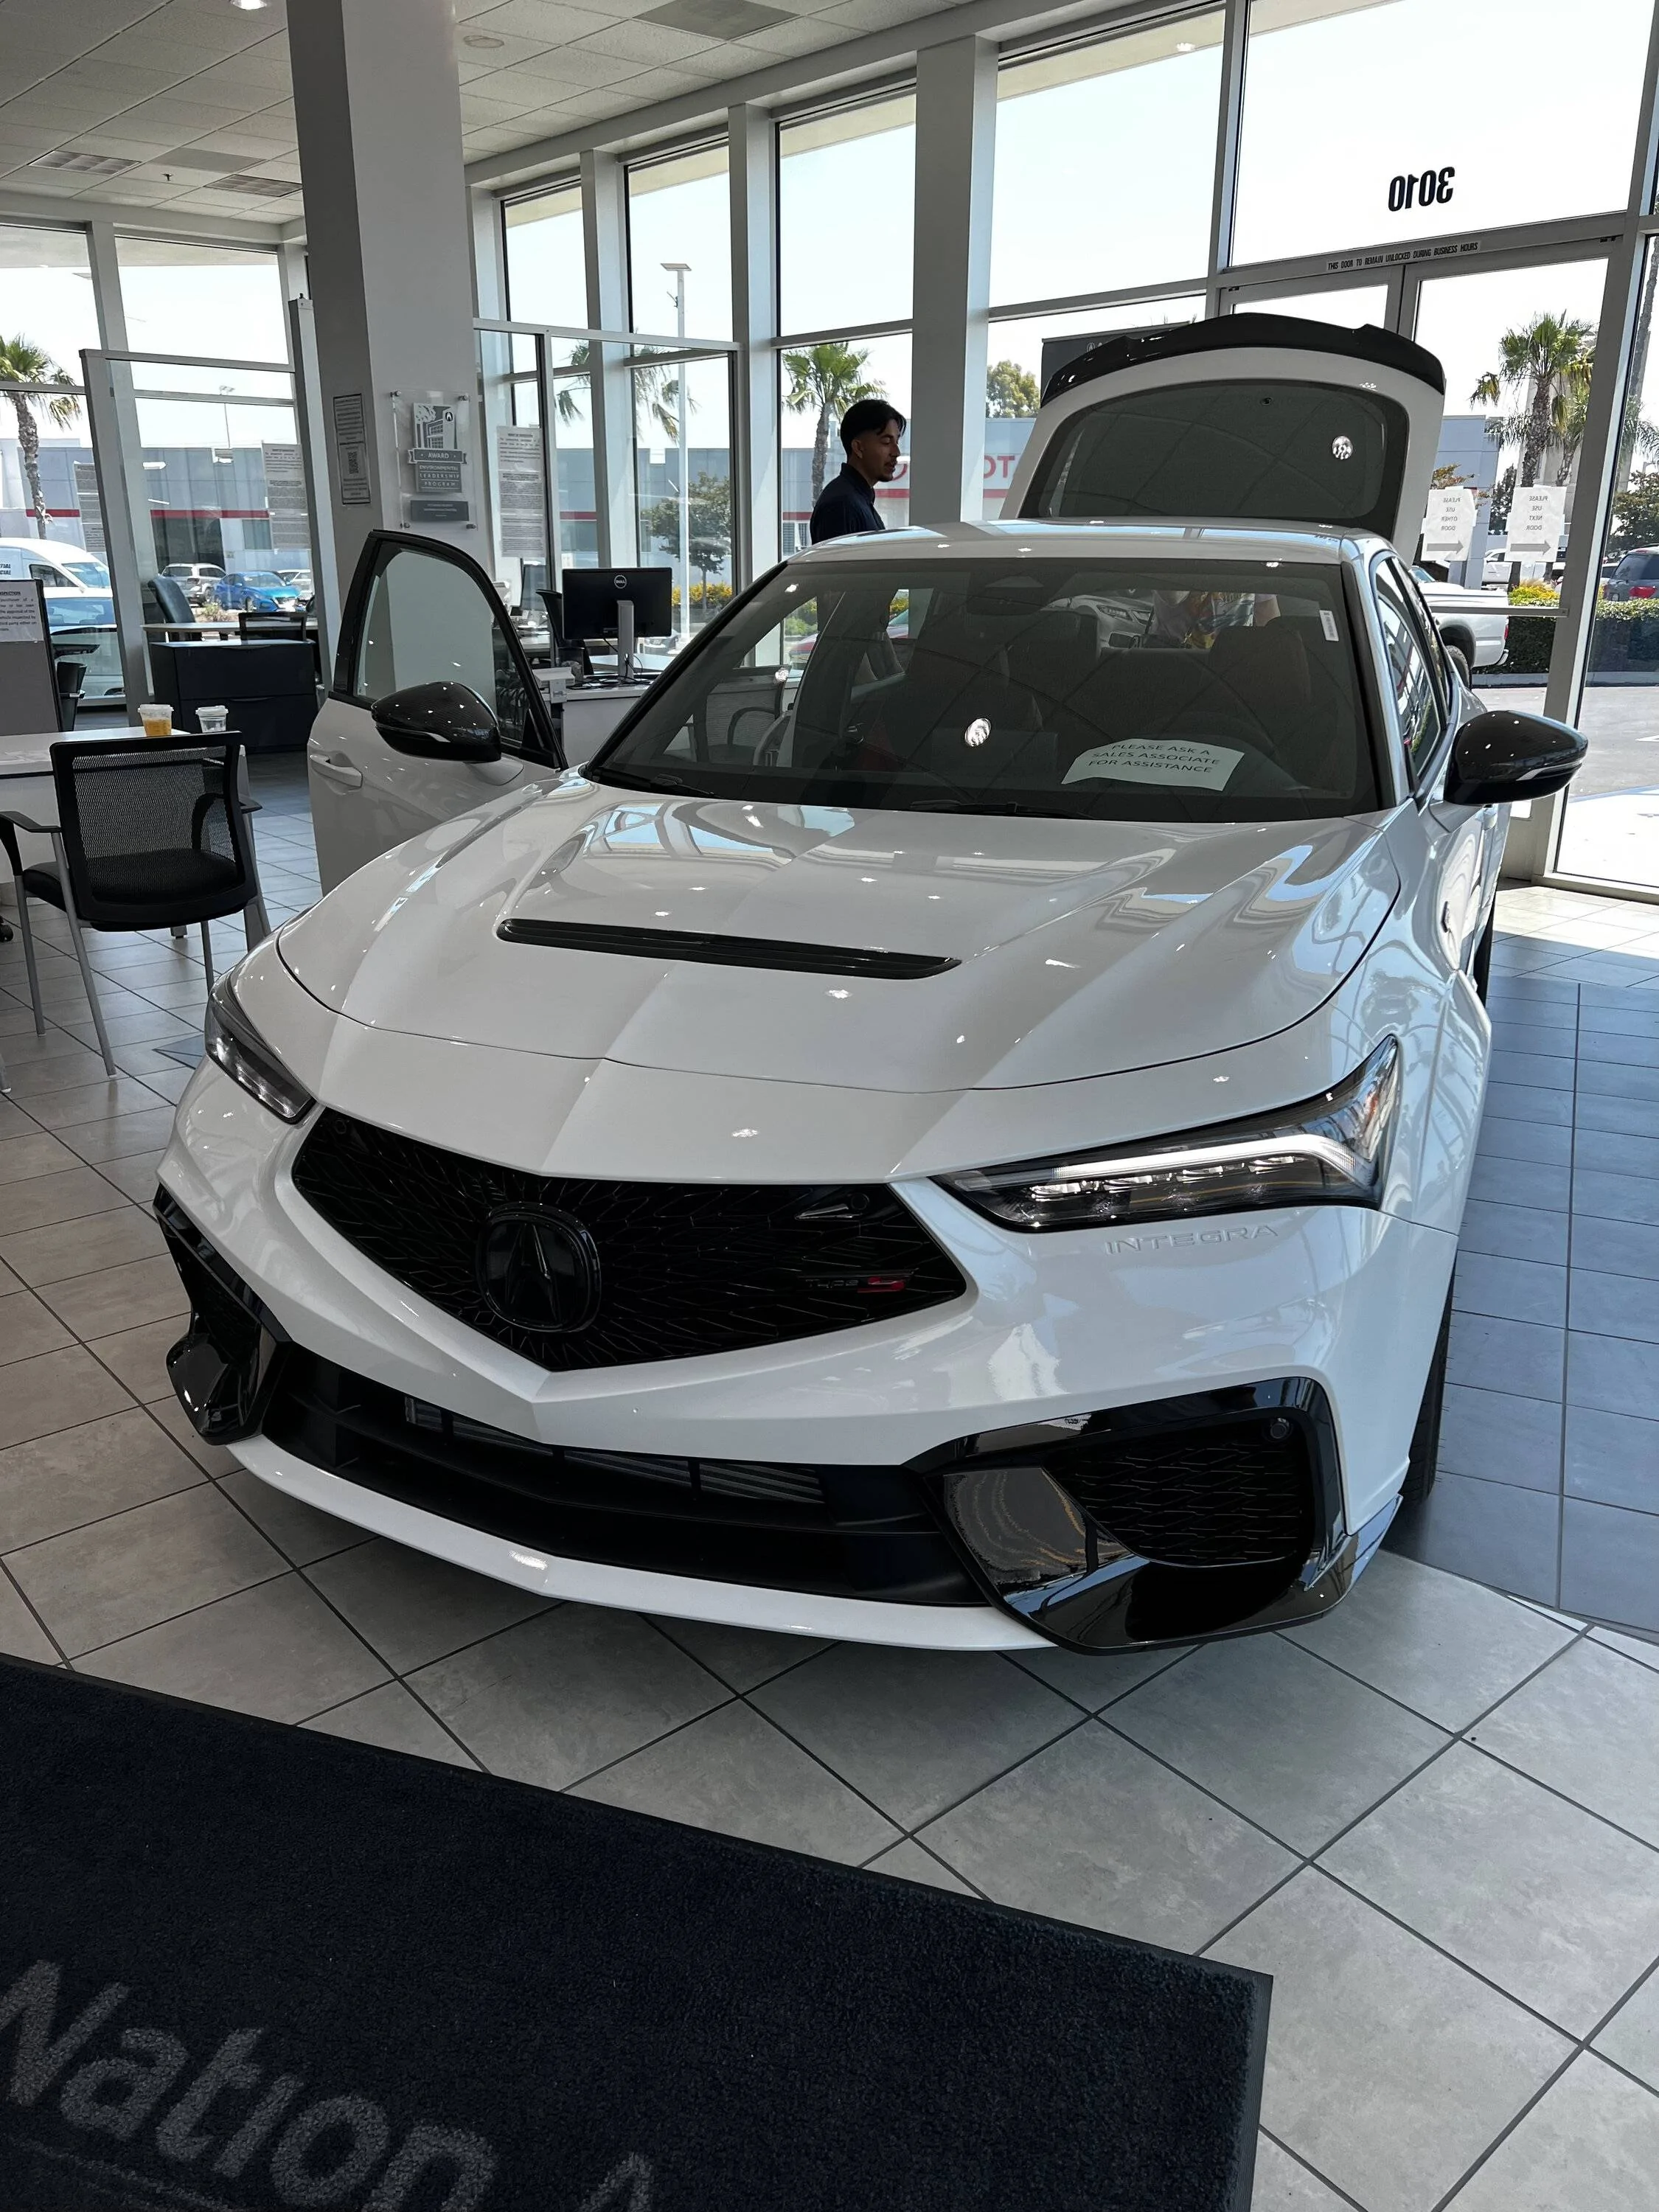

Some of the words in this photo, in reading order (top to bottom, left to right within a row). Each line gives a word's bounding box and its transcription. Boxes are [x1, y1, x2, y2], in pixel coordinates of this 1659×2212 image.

[1328, 262, 1339, 271] THIS
[1340, 260, 1354, 269] DOOR
[1356, 259, 1363, 267] TO
[1364, 255, 1383, 265] REMAIN
[1385, 251, 1411, 262] UNLOCKED
[1413, 248, 1432, 259] DURING
[1433, 244, 1458, 257] BUSINESS
[1460, 242, 1478, 252] HOURS
[1168, 745, 1194, 754] ASK
[1140, 753, 1221, 765] ASSOCIATE
[1121, 760, 1214, 773] ASSISTANCE
[1105, 1225, 1279, 1255] INTEGRA
